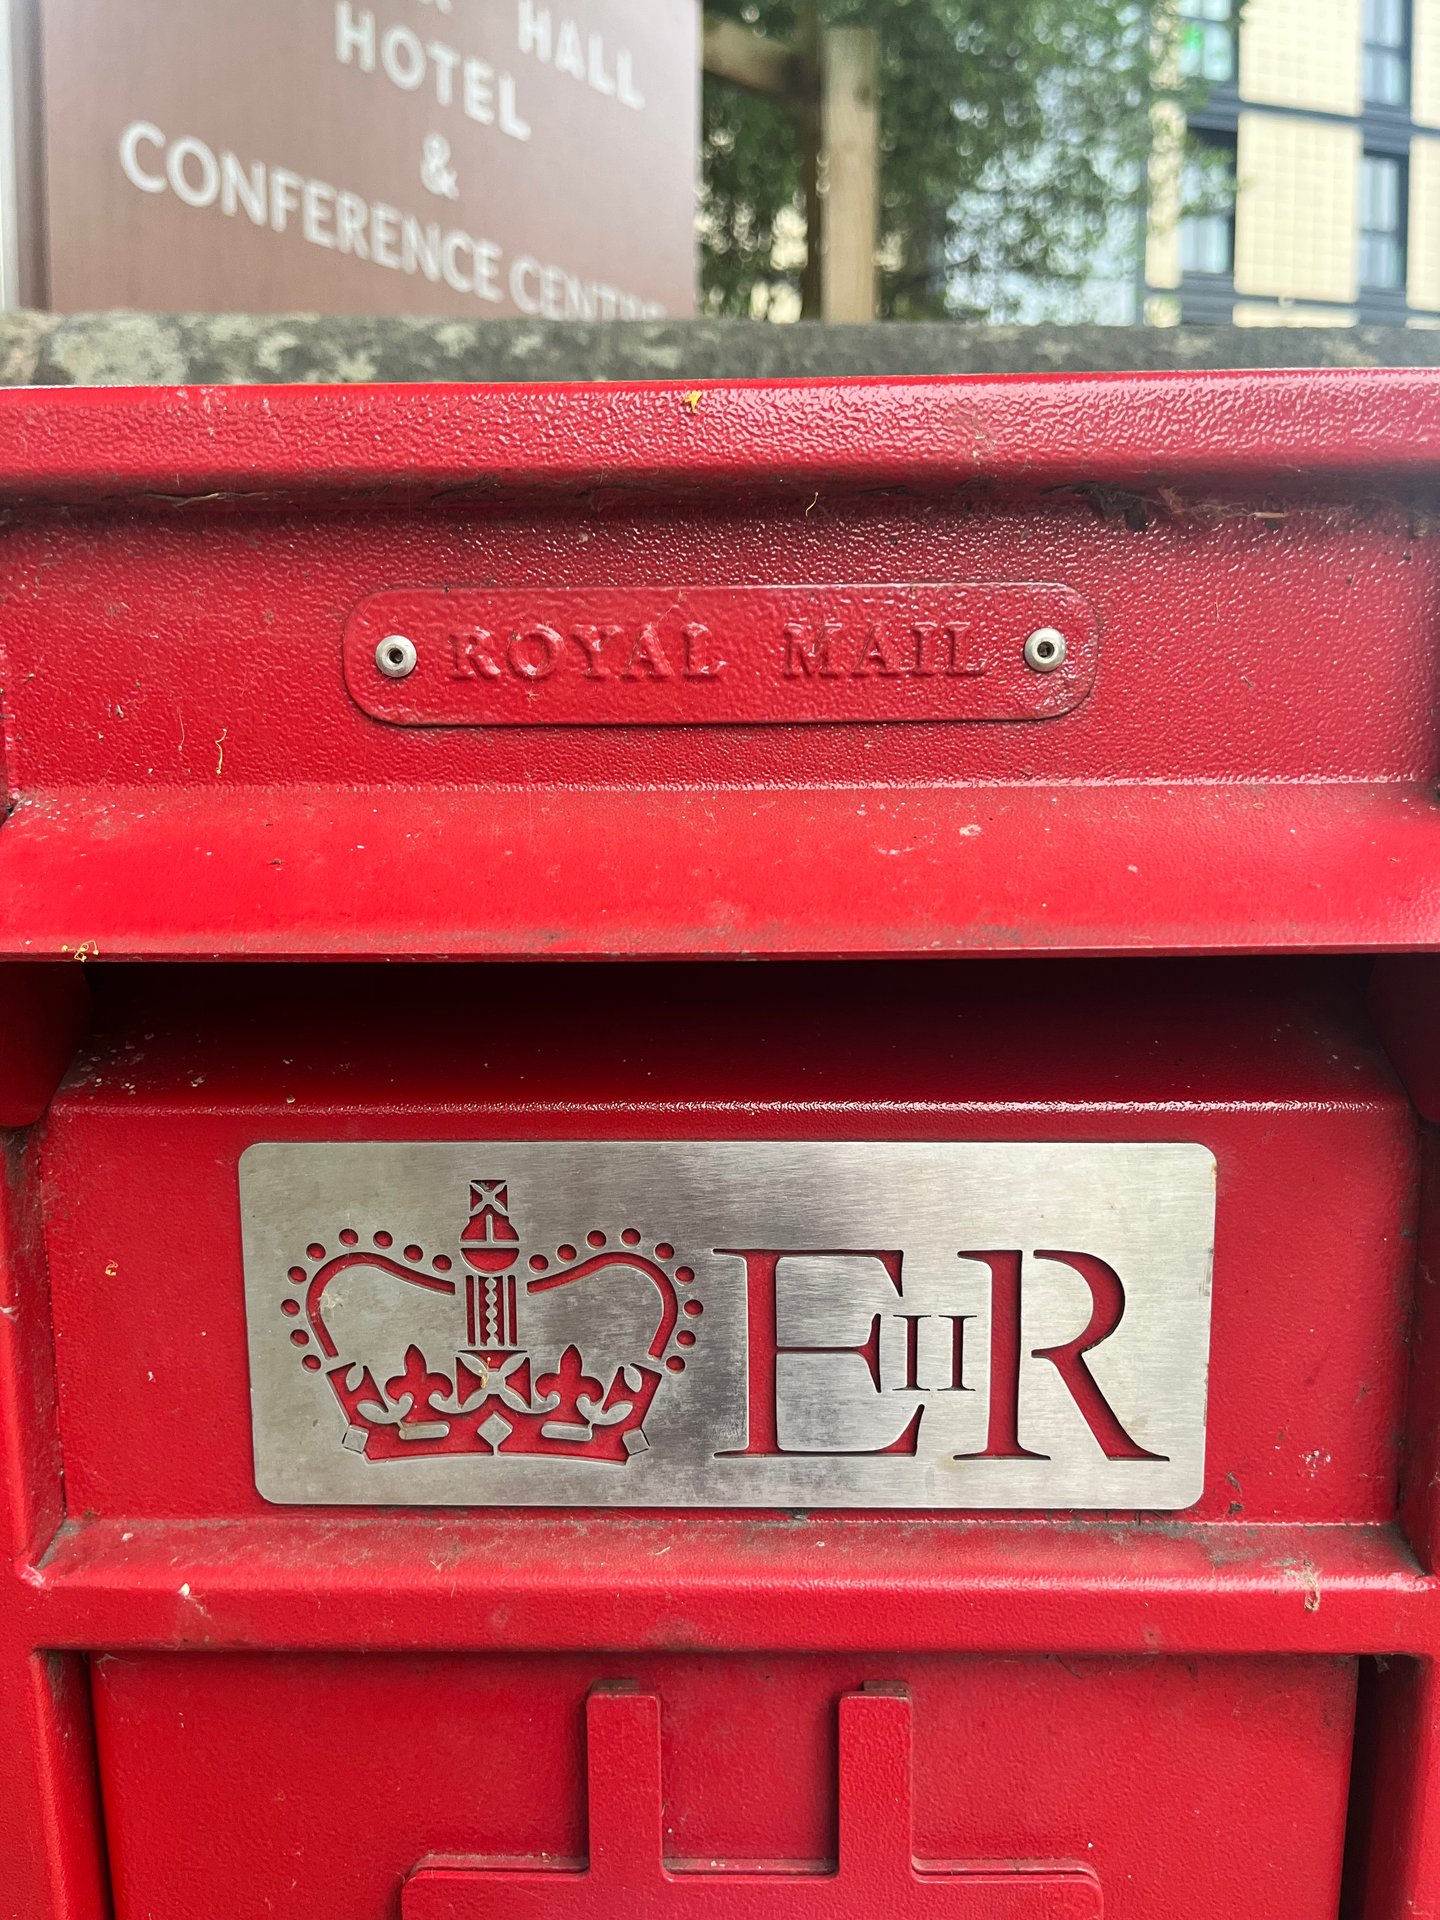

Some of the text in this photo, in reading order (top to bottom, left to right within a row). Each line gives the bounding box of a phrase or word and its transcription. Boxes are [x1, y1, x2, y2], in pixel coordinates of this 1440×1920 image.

[334, 1, 532, 141] HOTEL
[517, 0, 647, 111] HALL
[118, 120, 503, 304] CONFERENCE
[419, 131, 460, 200] &
[450, 620, 989, 681] ROYAL MAIL
